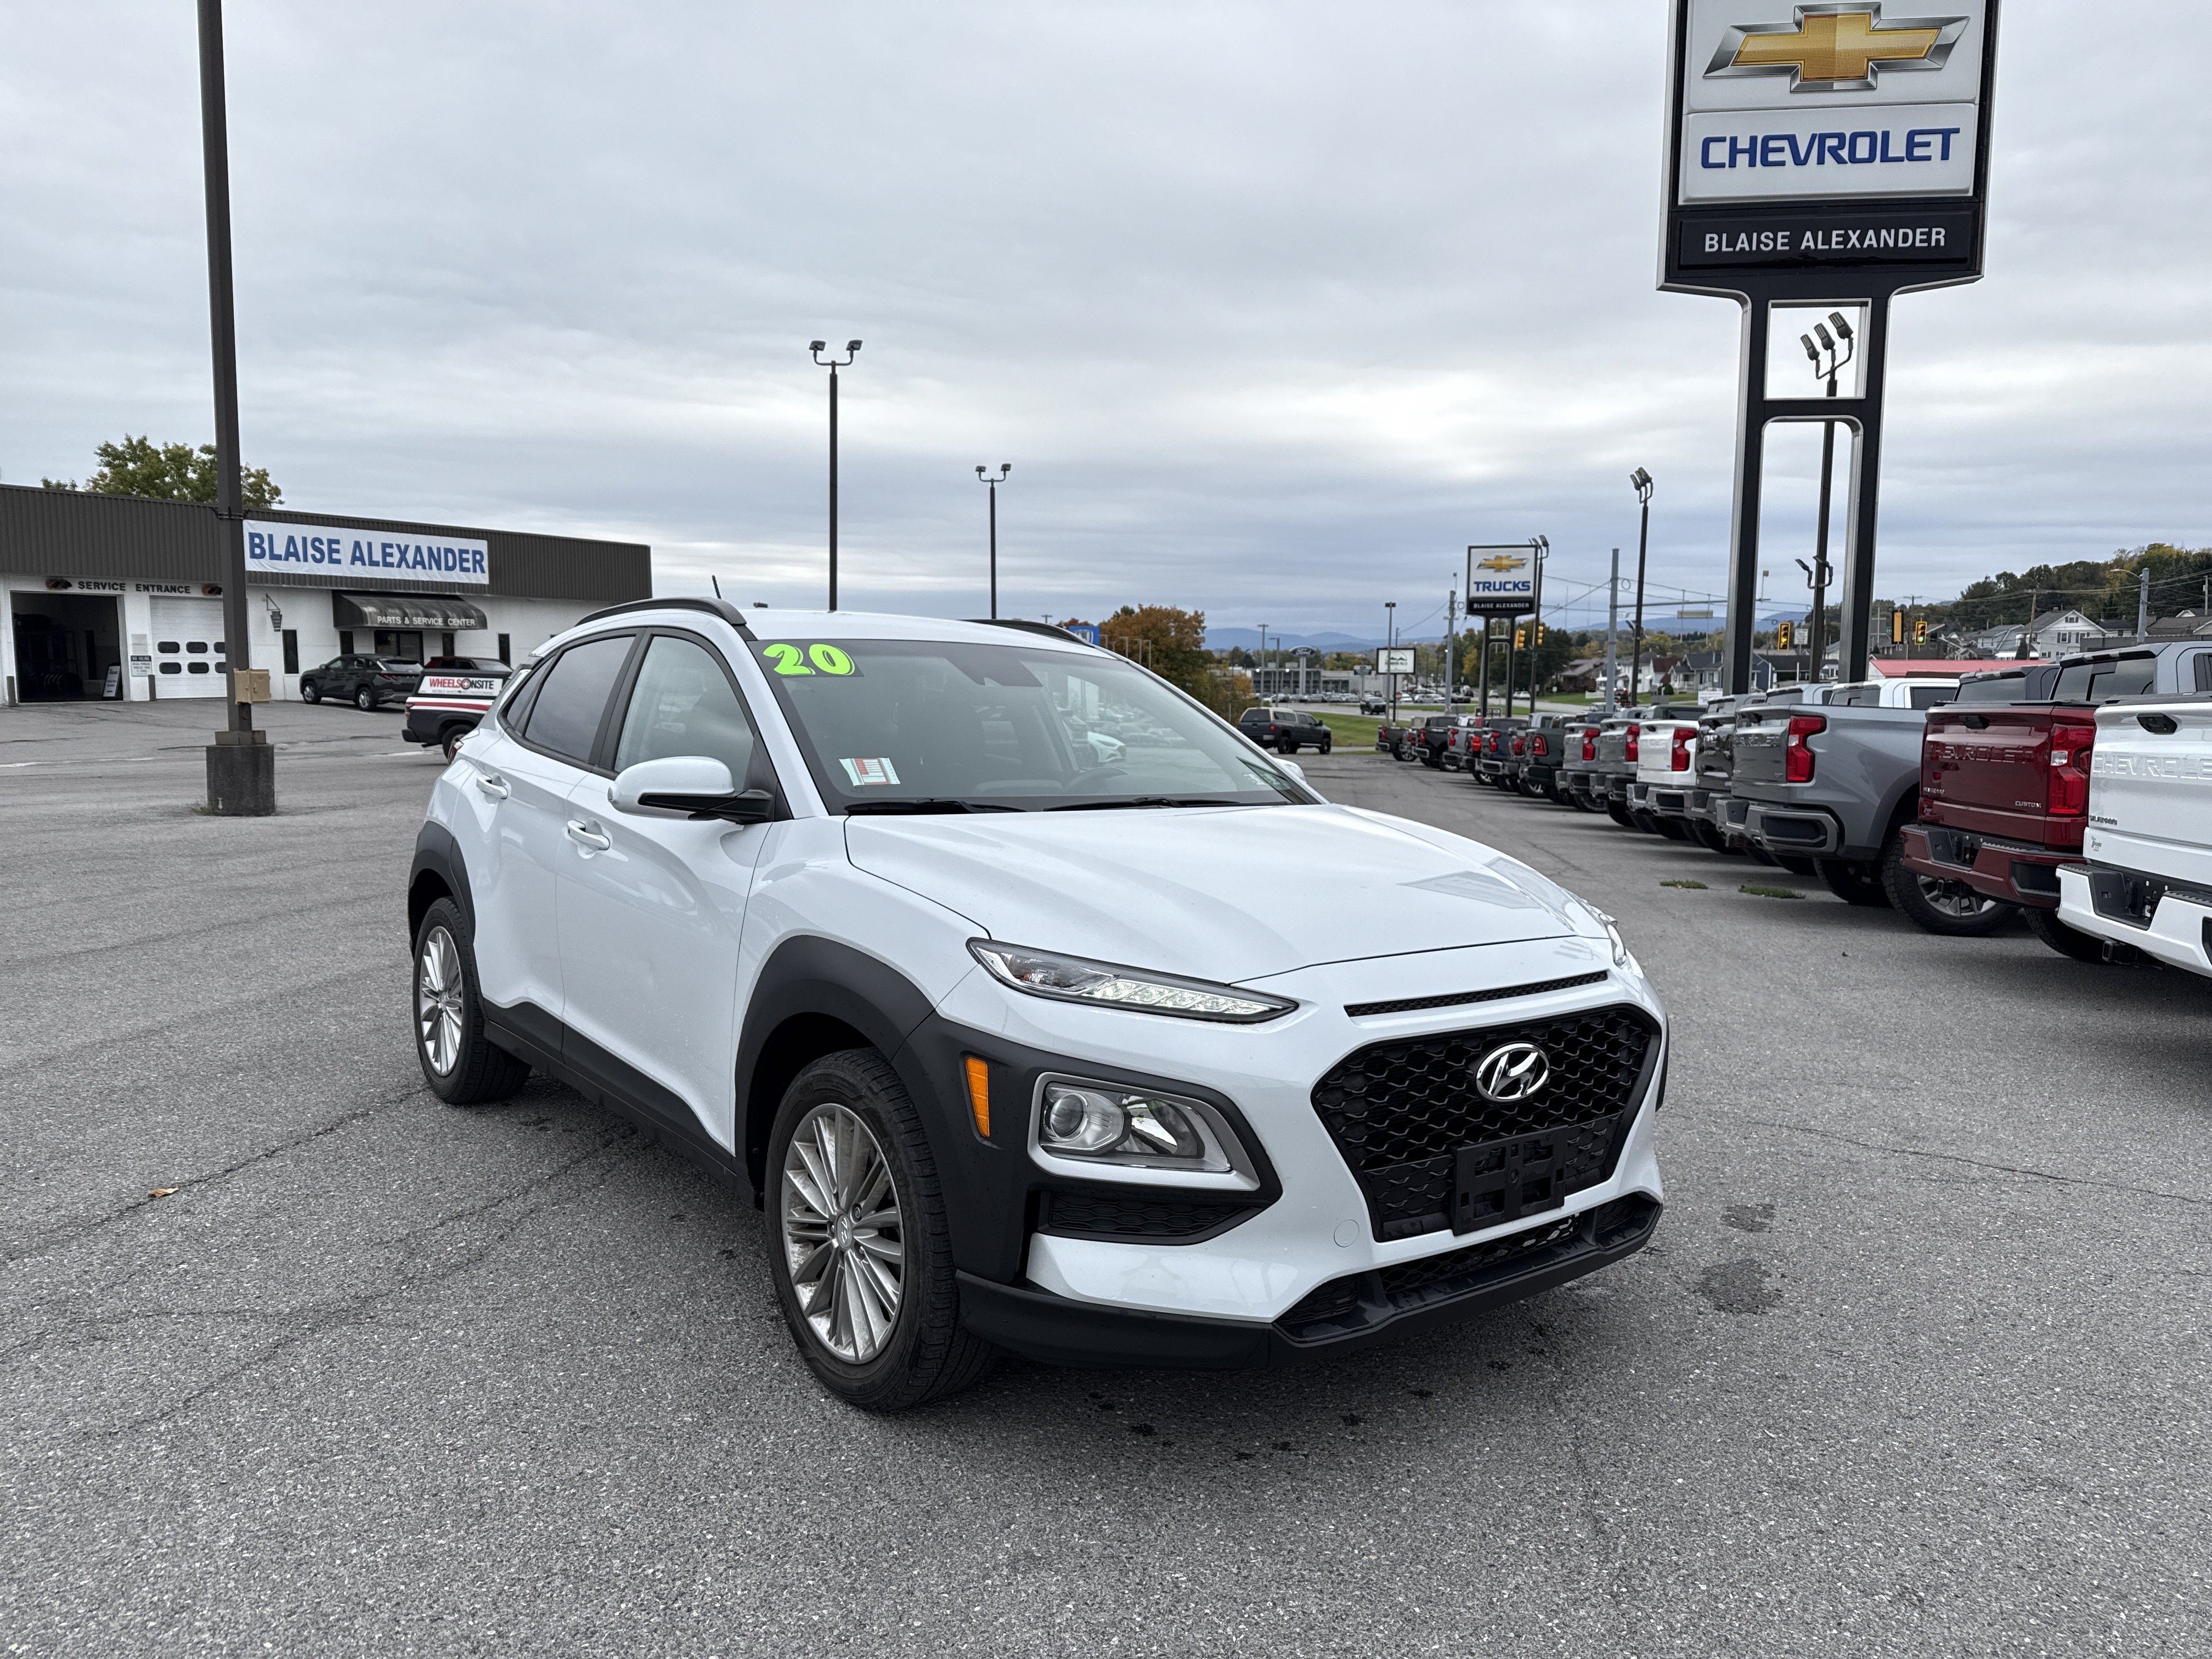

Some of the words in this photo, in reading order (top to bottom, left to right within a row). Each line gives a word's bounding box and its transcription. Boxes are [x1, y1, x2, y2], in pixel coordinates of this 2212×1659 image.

[1701, 127, 1960, 168] CHEVROLET
[1705, 231, 1790, 253] BLAISE
[1801, 227, 1946, 250] ALEXANDER
[248, 532, 342, 565] BLAISE
[350, 540, 486, 574] ALEXANDER
[78, 581, 126, 591] SERVICE
[136, 584, 190, 594] ENTRANCE
[1474, 580, 1531, 591] TRUCKS
[413, 617, 443, 625] SERVICE
[764, 644, 855, 676] 20
